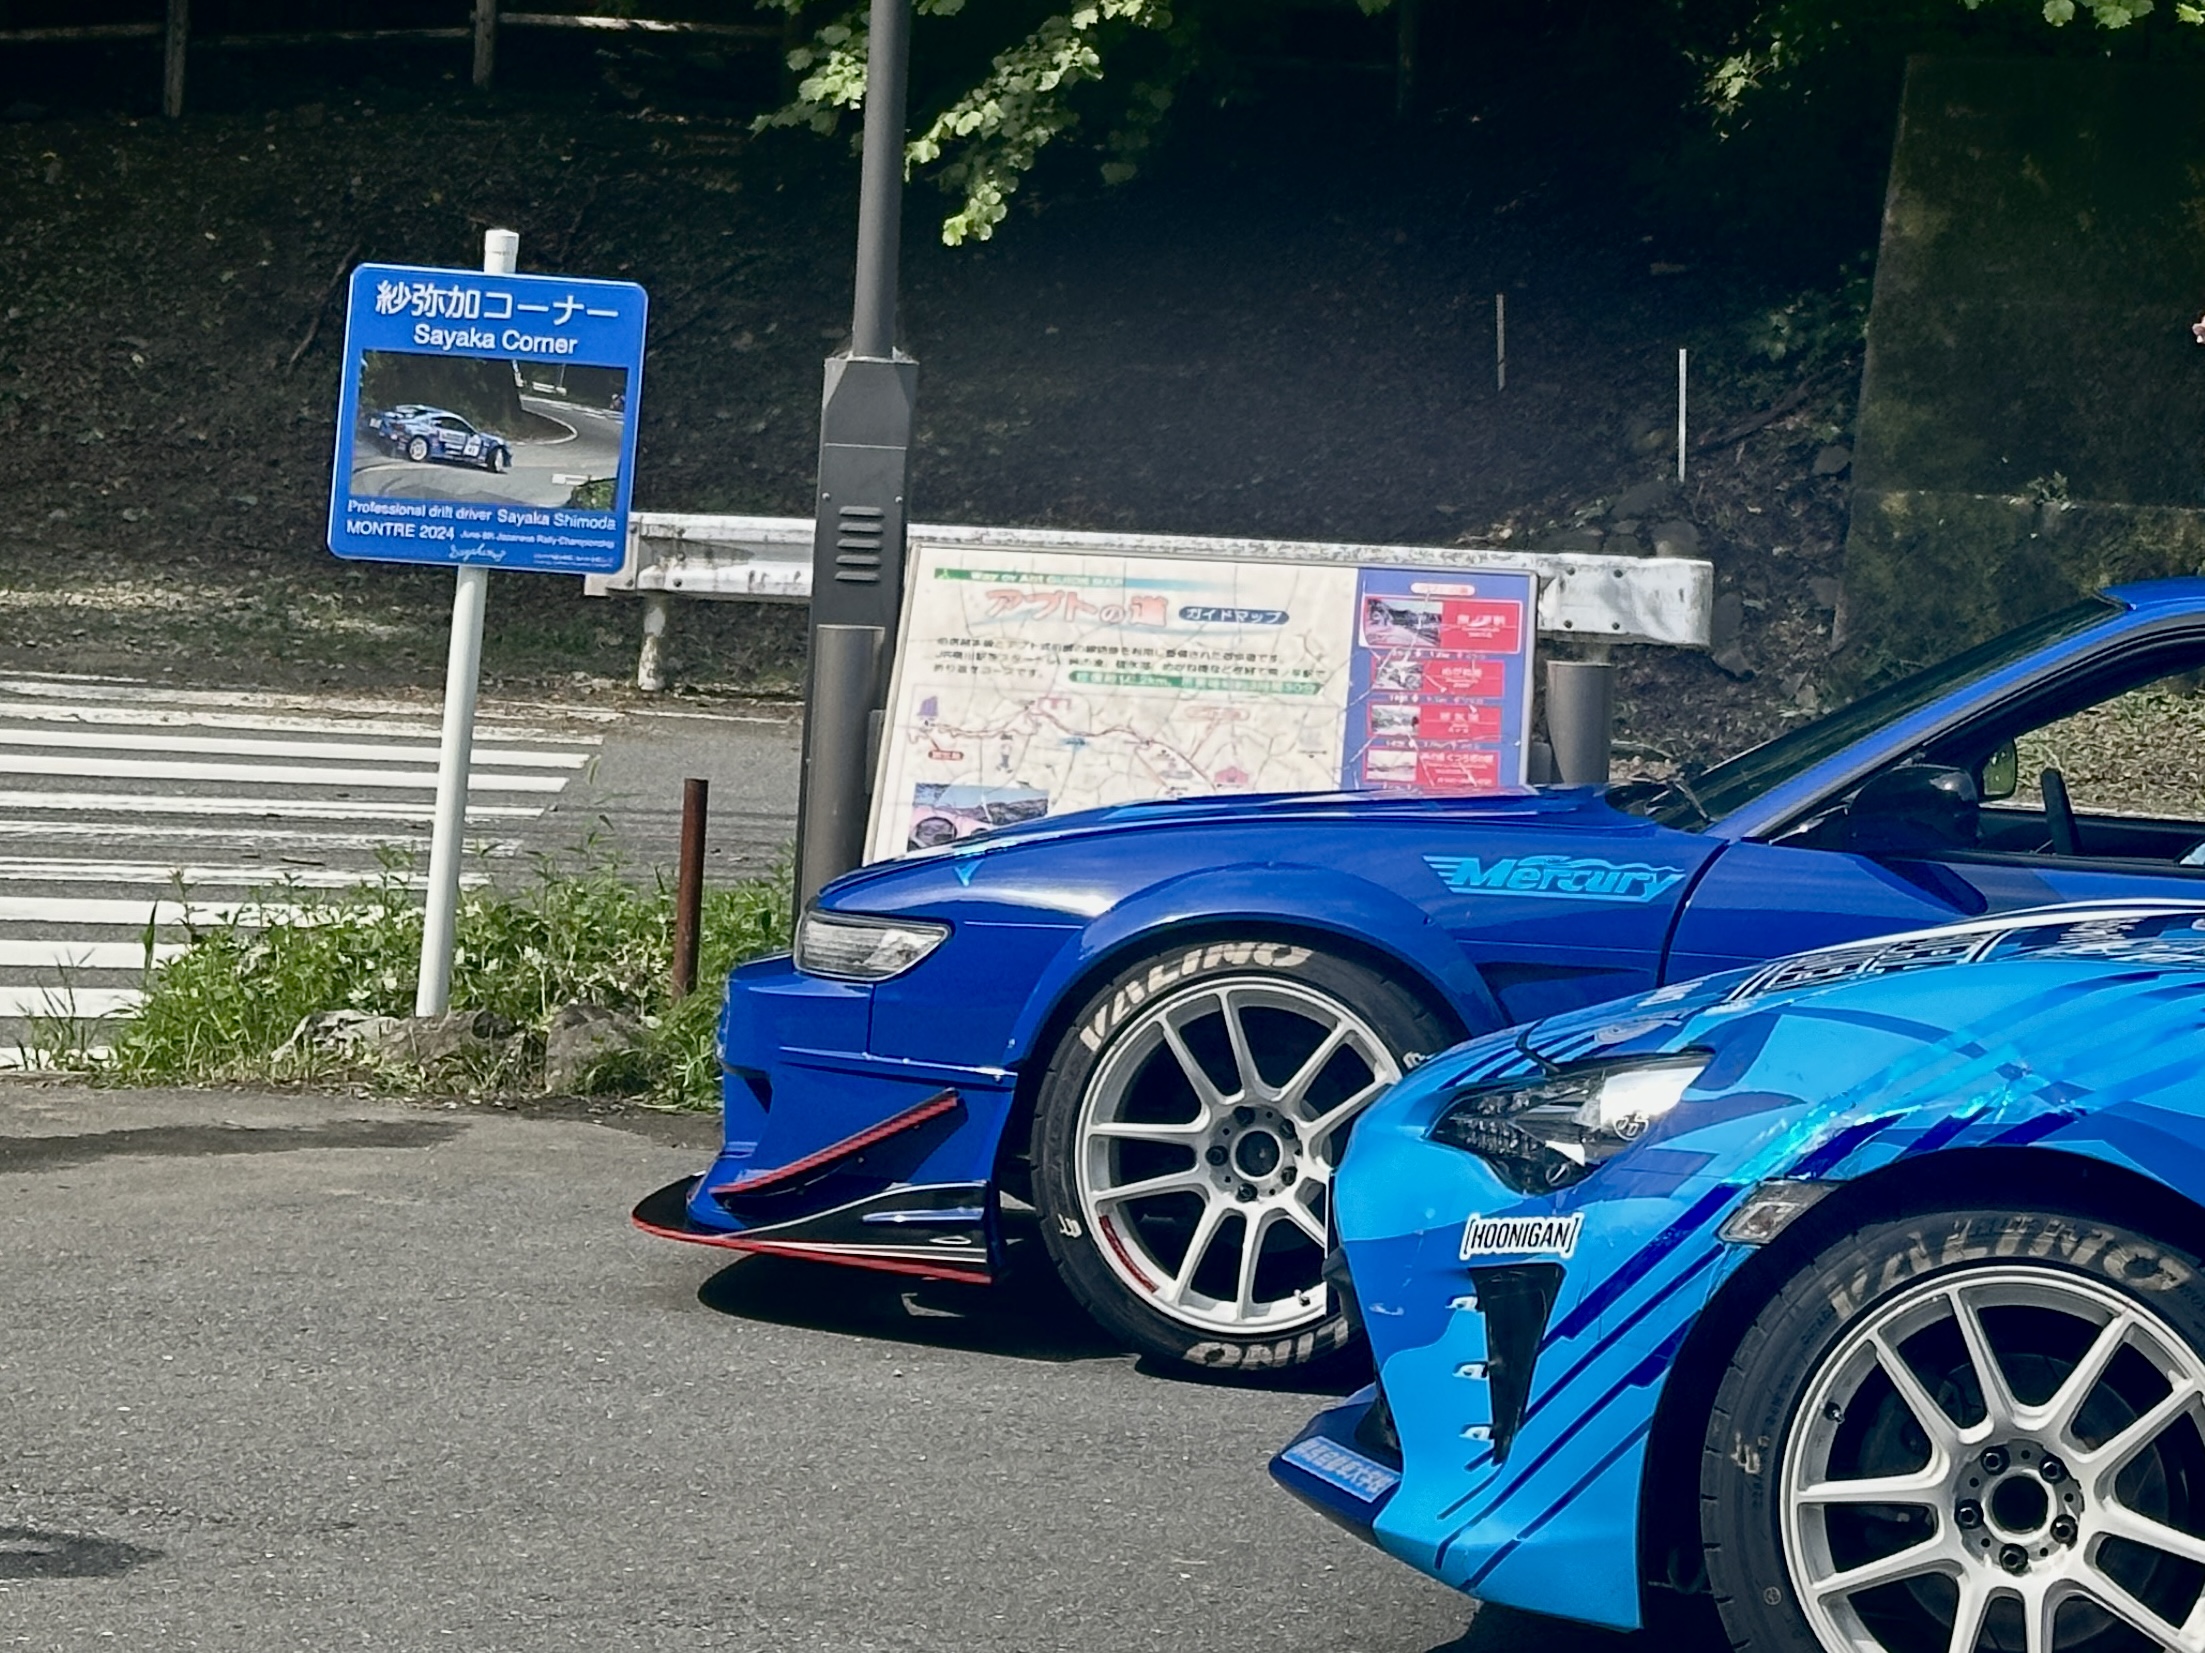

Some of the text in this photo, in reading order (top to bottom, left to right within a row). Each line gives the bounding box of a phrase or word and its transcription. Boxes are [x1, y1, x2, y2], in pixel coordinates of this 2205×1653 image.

[375, 280, 619, 326] 紗弥加コーナー
[413, 324, 578, 354] Sayaka Corner
[346, 520, 416, 537] MONTRE
[419, 525, 454, 541] 2024
[347, 499, 425, 518] Professional
[456, 507, 492, 522] driver
[497, 508, 550, 527] Sayaka
[553, 513, 617, 531] Shimoda
[985, 589, 1284, 627] アプトの道 ガイドマップ
[1450, 857, 1686, 902] Mercury
[1079, 941, 1314, 1054] VALINO
[1822, 1213, 2194, 1321] VALINO
